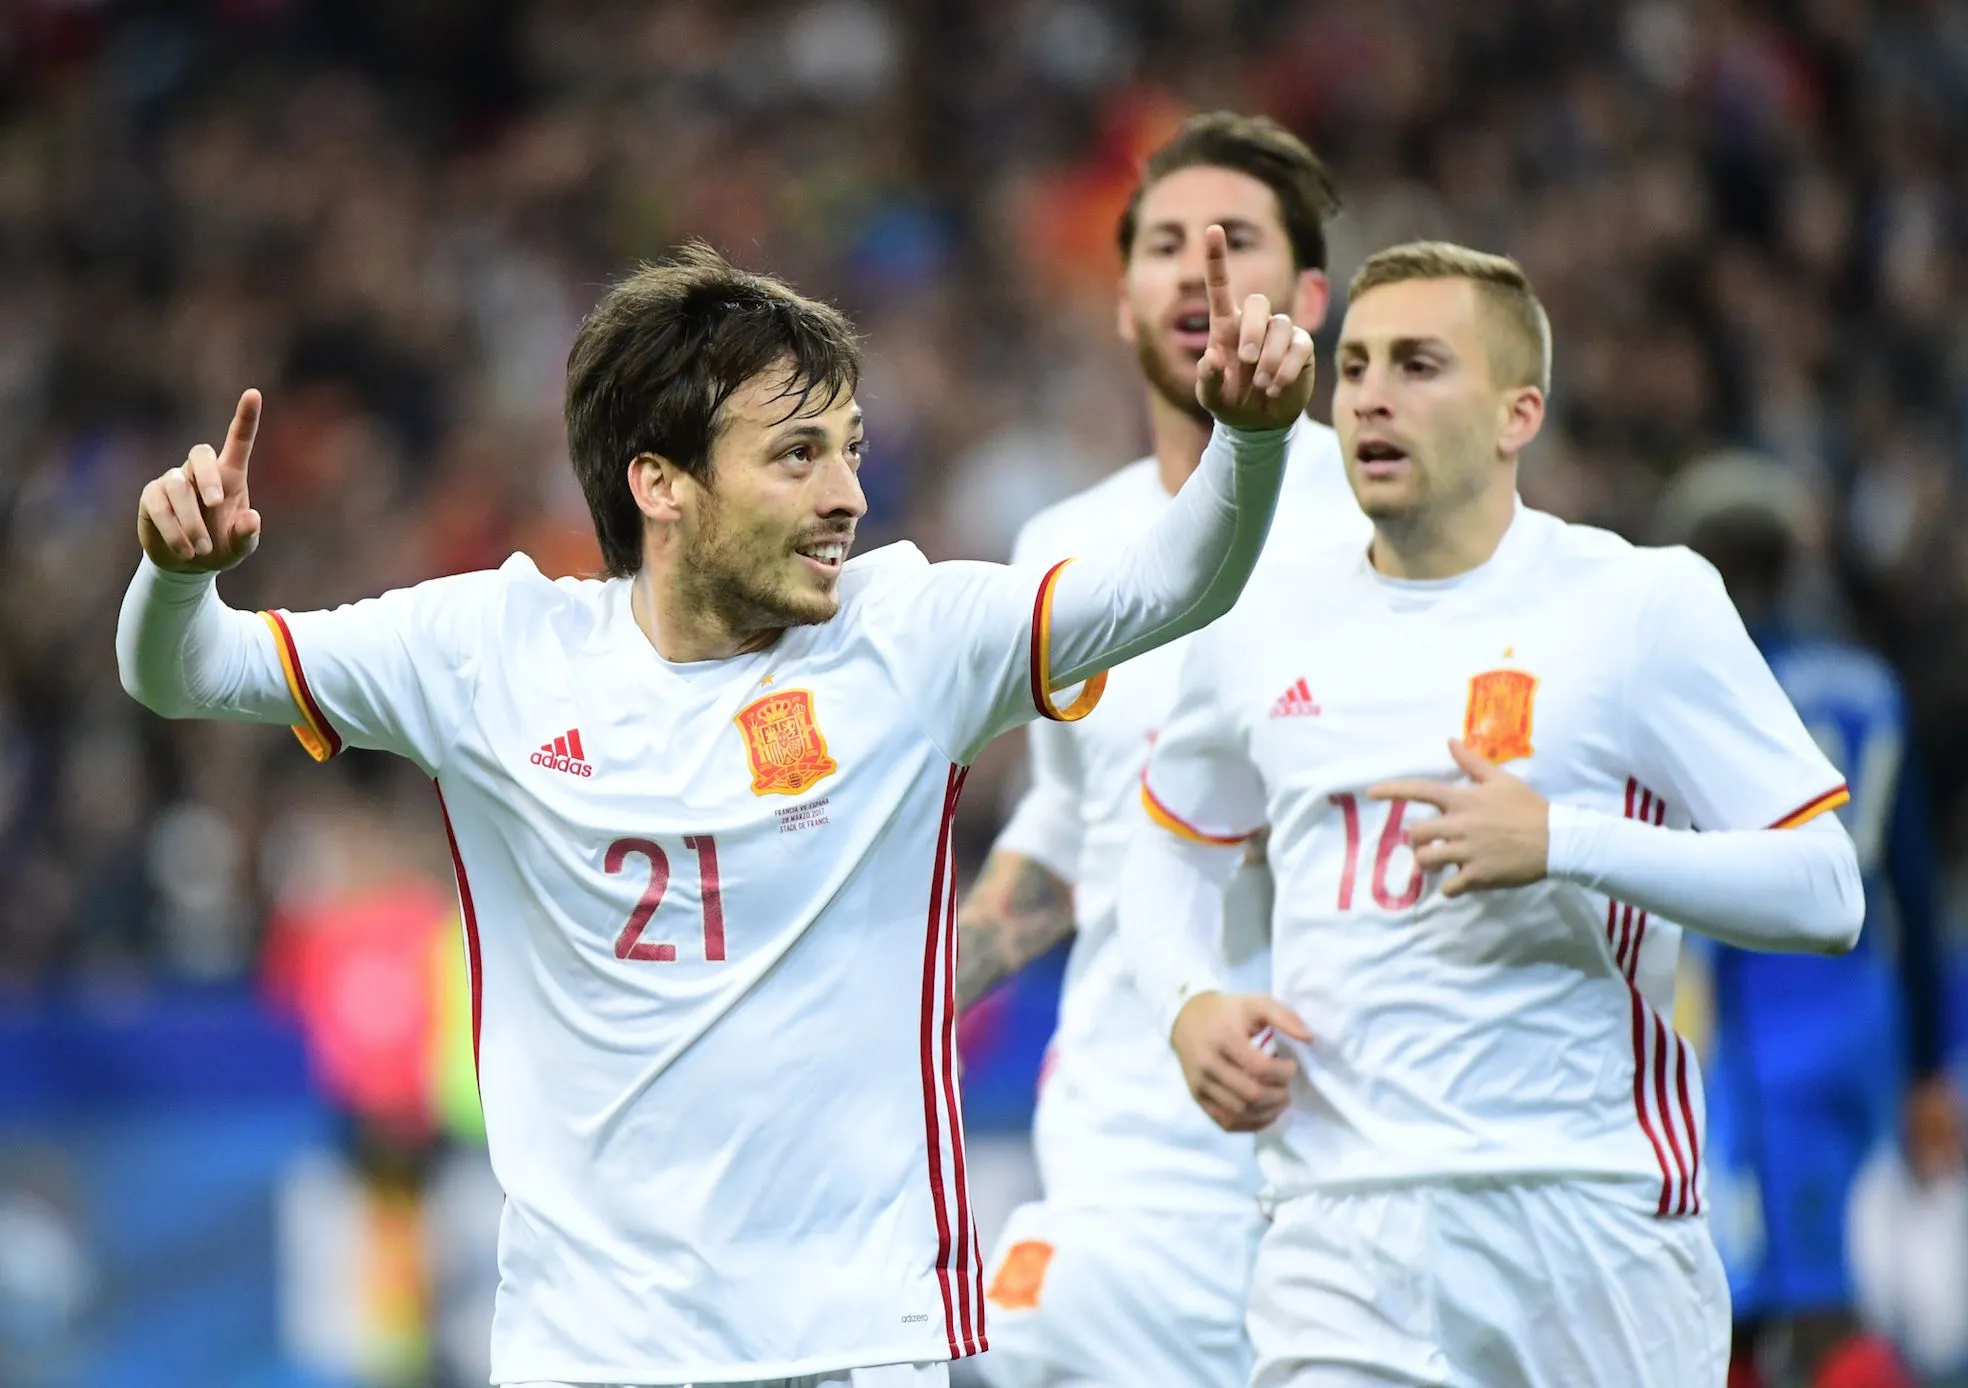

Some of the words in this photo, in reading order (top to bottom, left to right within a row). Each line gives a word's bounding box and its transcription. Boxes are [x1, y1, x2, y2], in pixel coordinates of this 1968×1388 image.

[530, 751, 592, 777] adidas
[780, 824, 797, 833] STADE
[807, 816, 830, 827] FRANCE
[790, 812, 811, 821] MARZO
[812, 807, 825, 818] 2017
[1329, 792, 1424, 911] 16
[604, 834, 726, 962] 21
[902, 1313, 929, 1323] adizero
